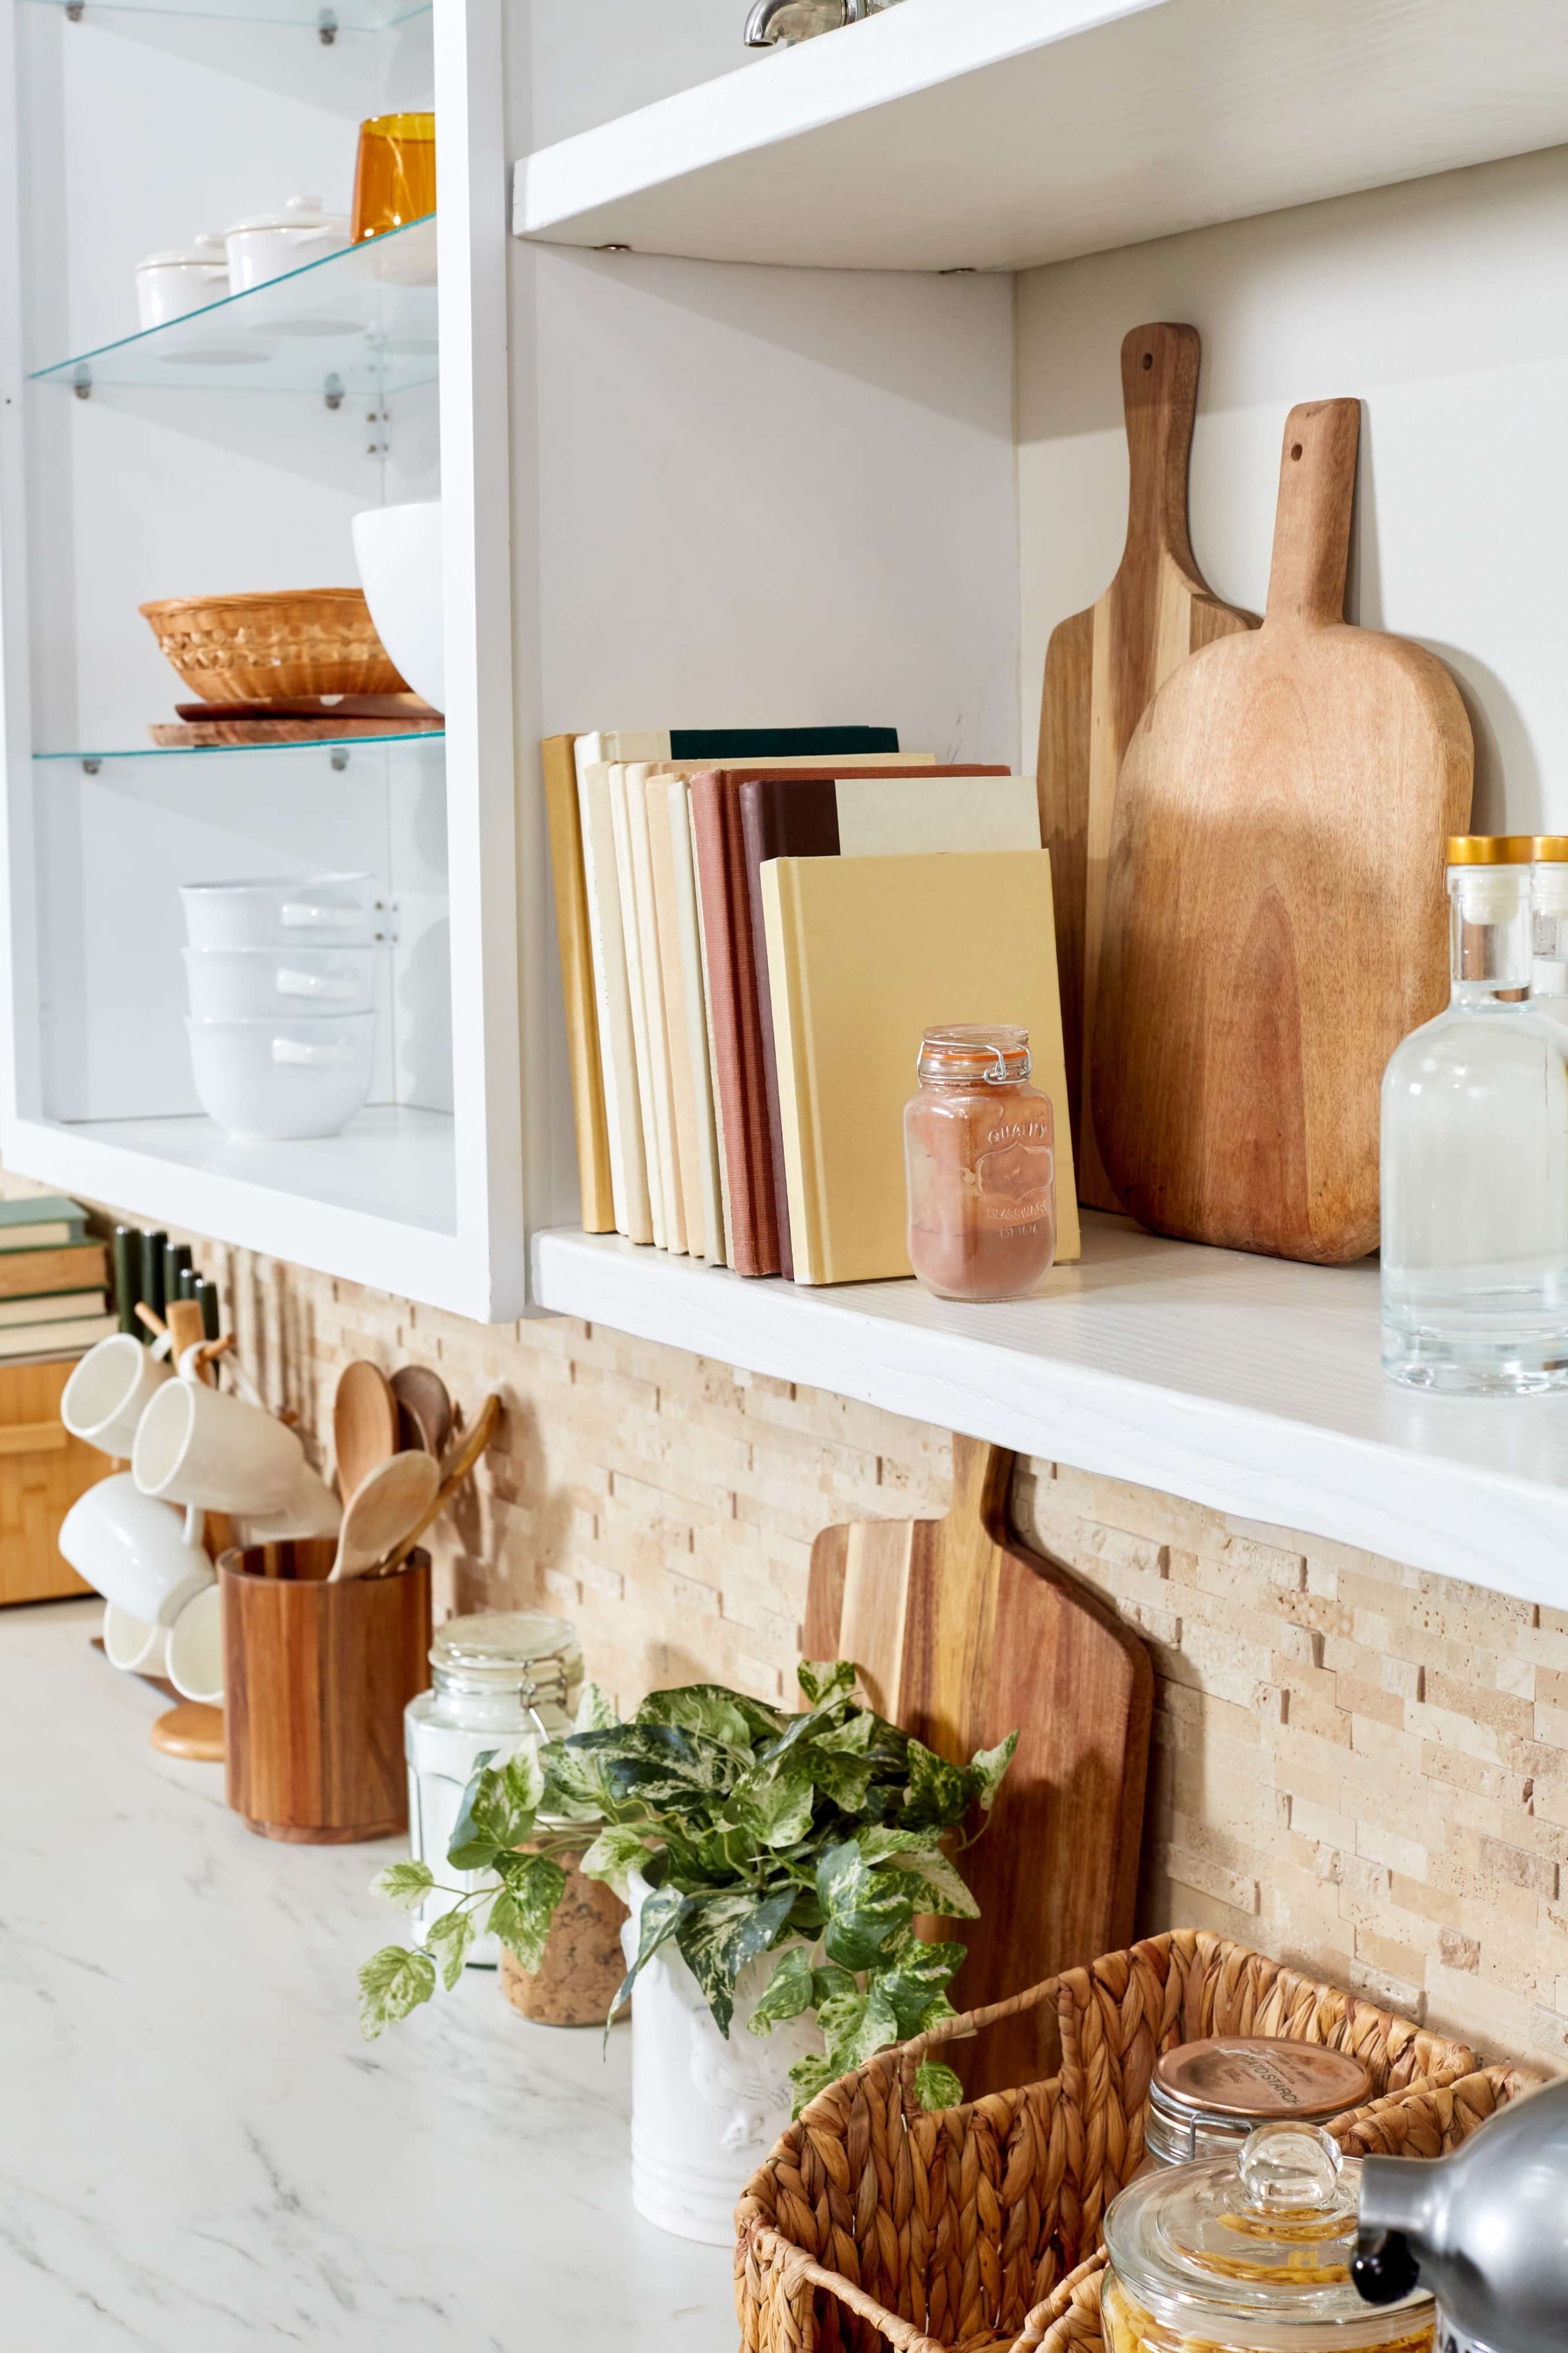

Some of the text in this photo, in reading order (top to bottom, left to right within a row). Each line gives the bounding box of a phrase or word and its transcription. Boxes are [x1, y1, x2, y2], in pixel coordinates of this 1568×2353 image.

[988, 1122, 1047, 1144] QUALITY
[987, 1199, 1050, 1220] GLASSWARE
[1234, 2052, 1269, 2074] OTATO
[1261, 2074, 1300, 2105] STARCH
